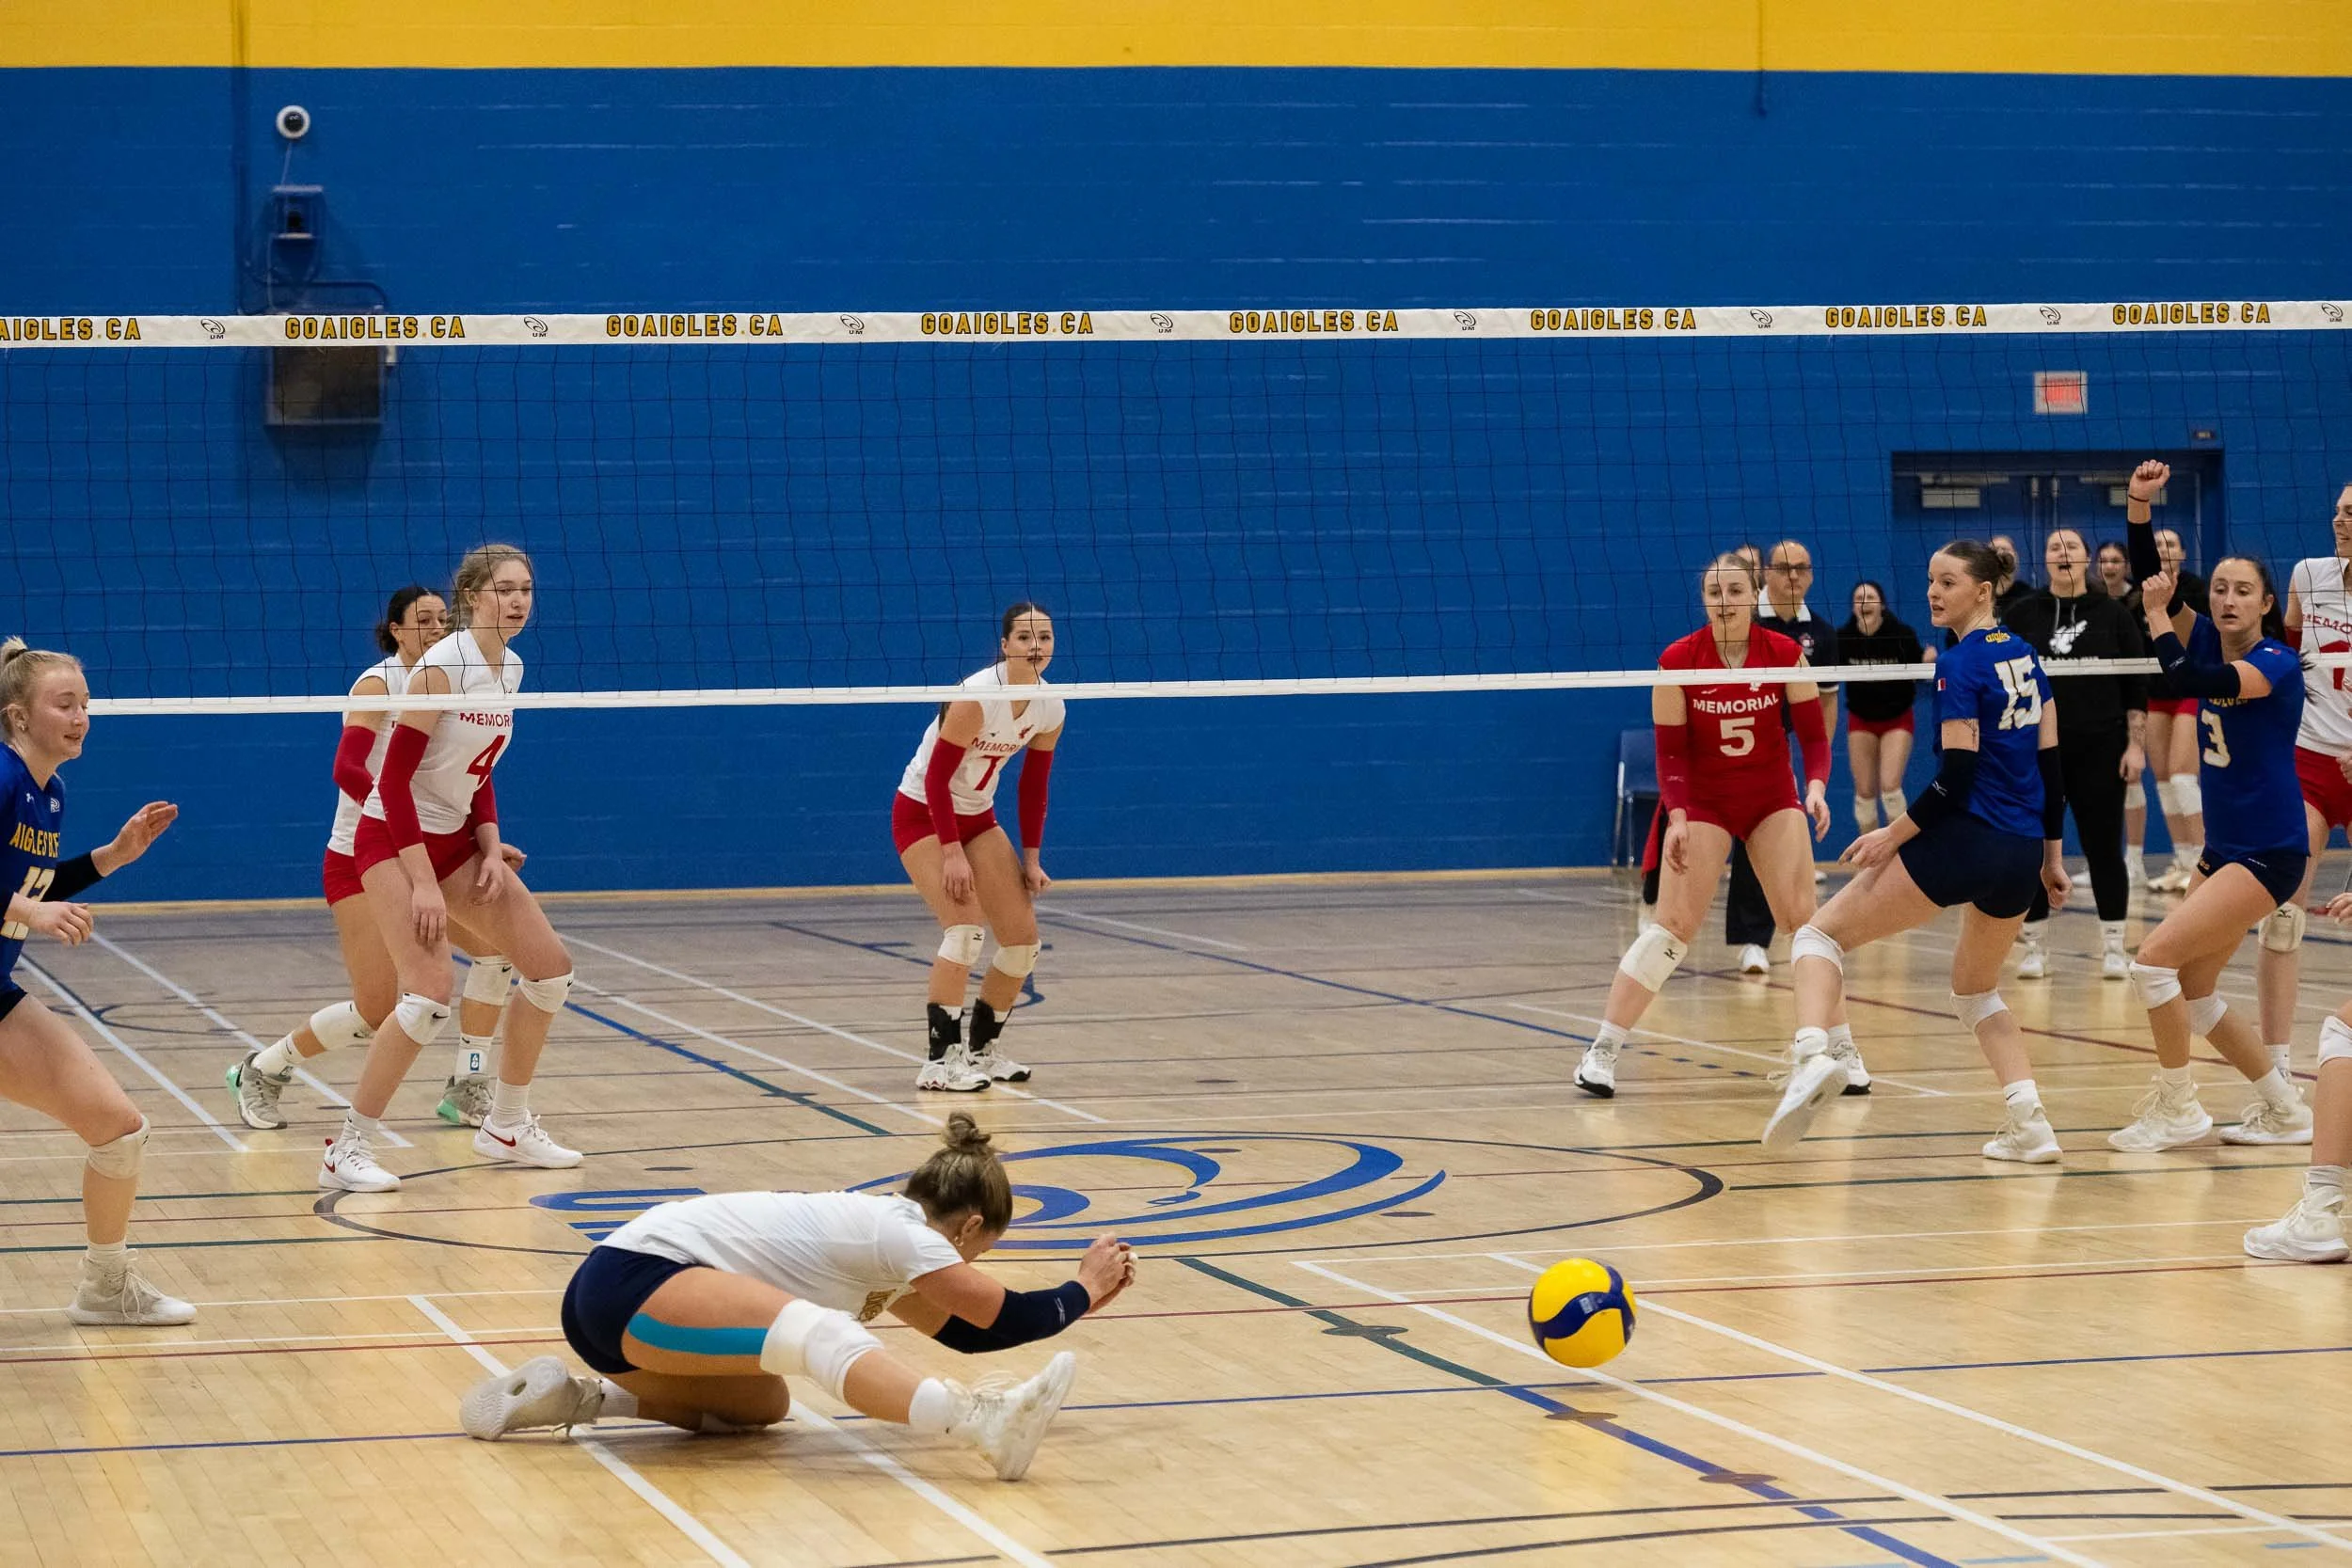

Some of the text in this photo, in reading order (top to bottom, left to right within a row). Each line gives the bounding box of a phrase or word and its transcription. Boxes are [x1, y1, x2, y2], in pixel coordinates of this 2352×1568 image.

[921, 312, 1093, 335] GOAIGLES.CA
[1229, 310, 1399, 334] GOAIGLES.CA
[1530, 308, 1696, 331] GOAIGLES.CA
[1825, 306, 1987, 328] GOAIGLES.CA
[2112, 302, 2271, 325] GOAIGLES.CA
[285, 316, 466, 340] GOAIGLES.CA
[606, 314, 784, 338] GOAIGLES.CA
[1692, 692, 1779, 714] MEMORIAL
[1994, 655, 2042, 730] 15
[1720, 717, 1756, 756] 5
[2201, 708, 2232, 768] 3
[466, 735, 506, 786] 4
[975, 755, 1005, 790] 7
[8, 821, 48, 857] AIGLES
